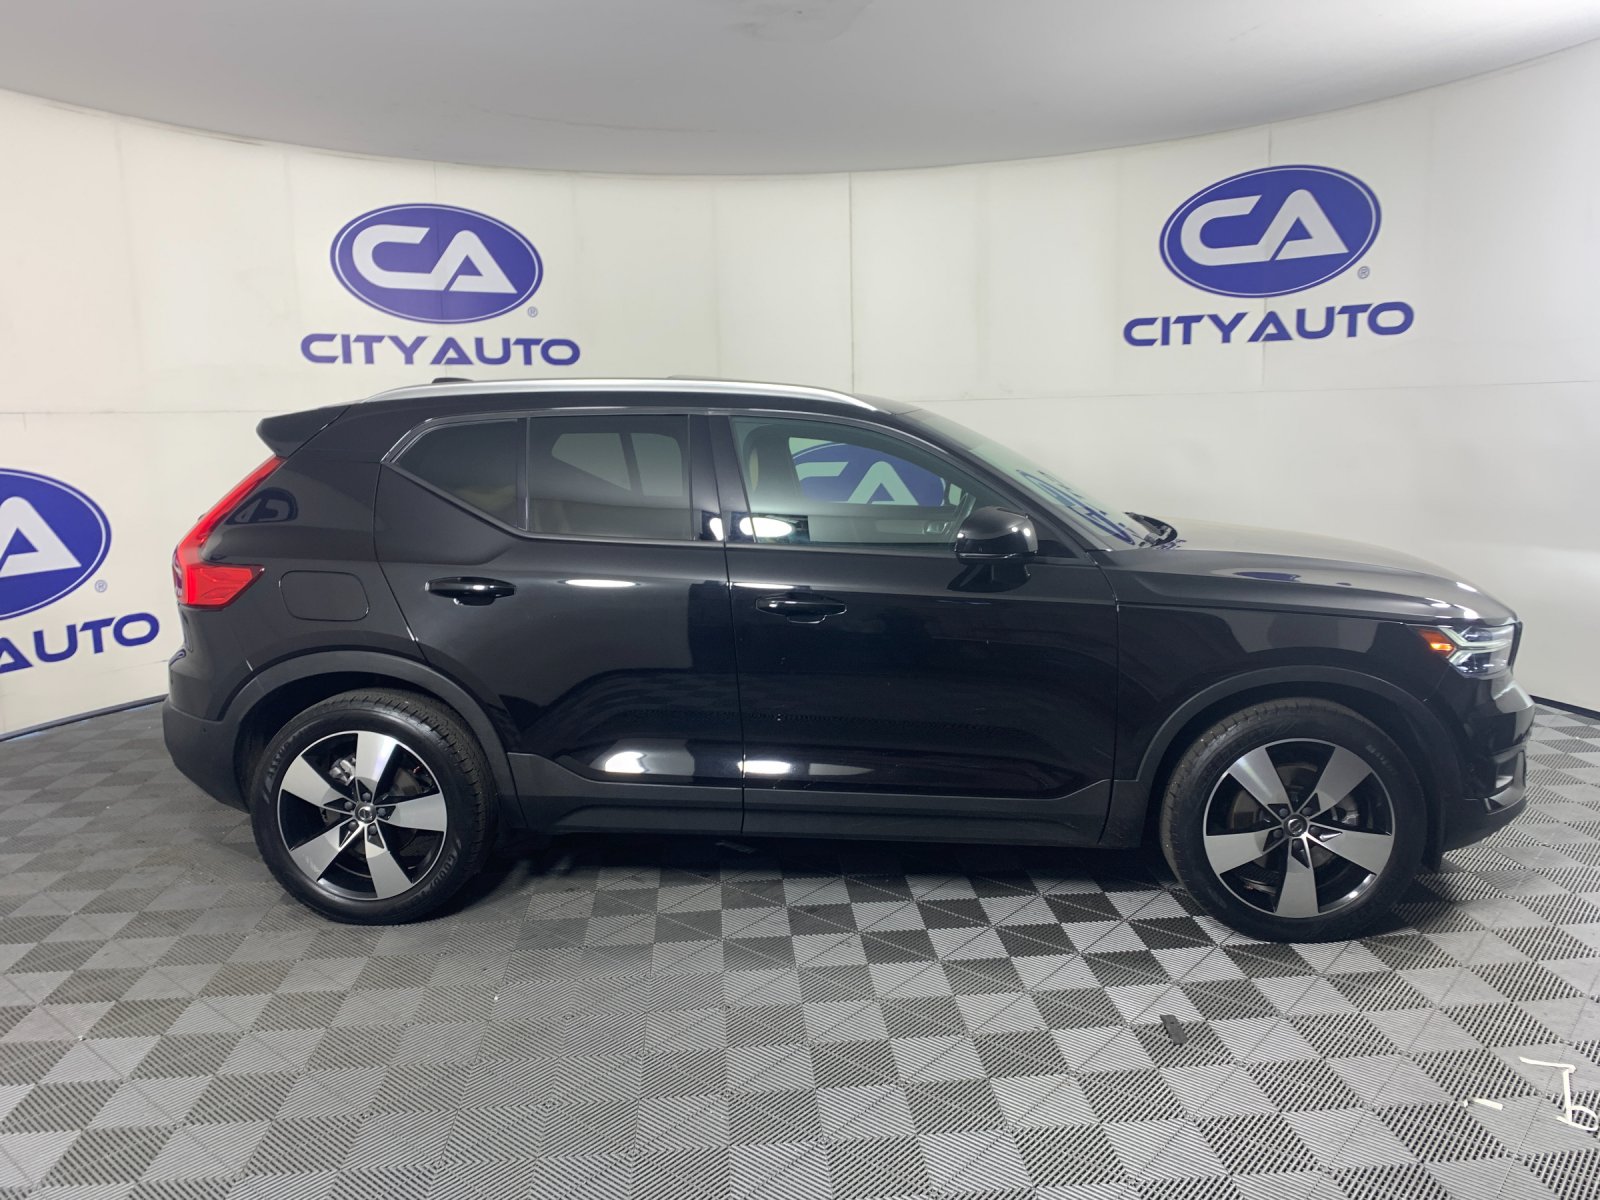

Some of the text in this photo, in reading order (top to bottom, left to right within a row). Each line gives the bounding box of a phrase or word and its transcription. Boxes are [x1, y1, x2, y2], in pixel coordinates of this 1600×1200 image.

[352, 223, 518, 294] CA
[1180, 188, 1350, 267] CA
[0, 495, 82, 579] A
